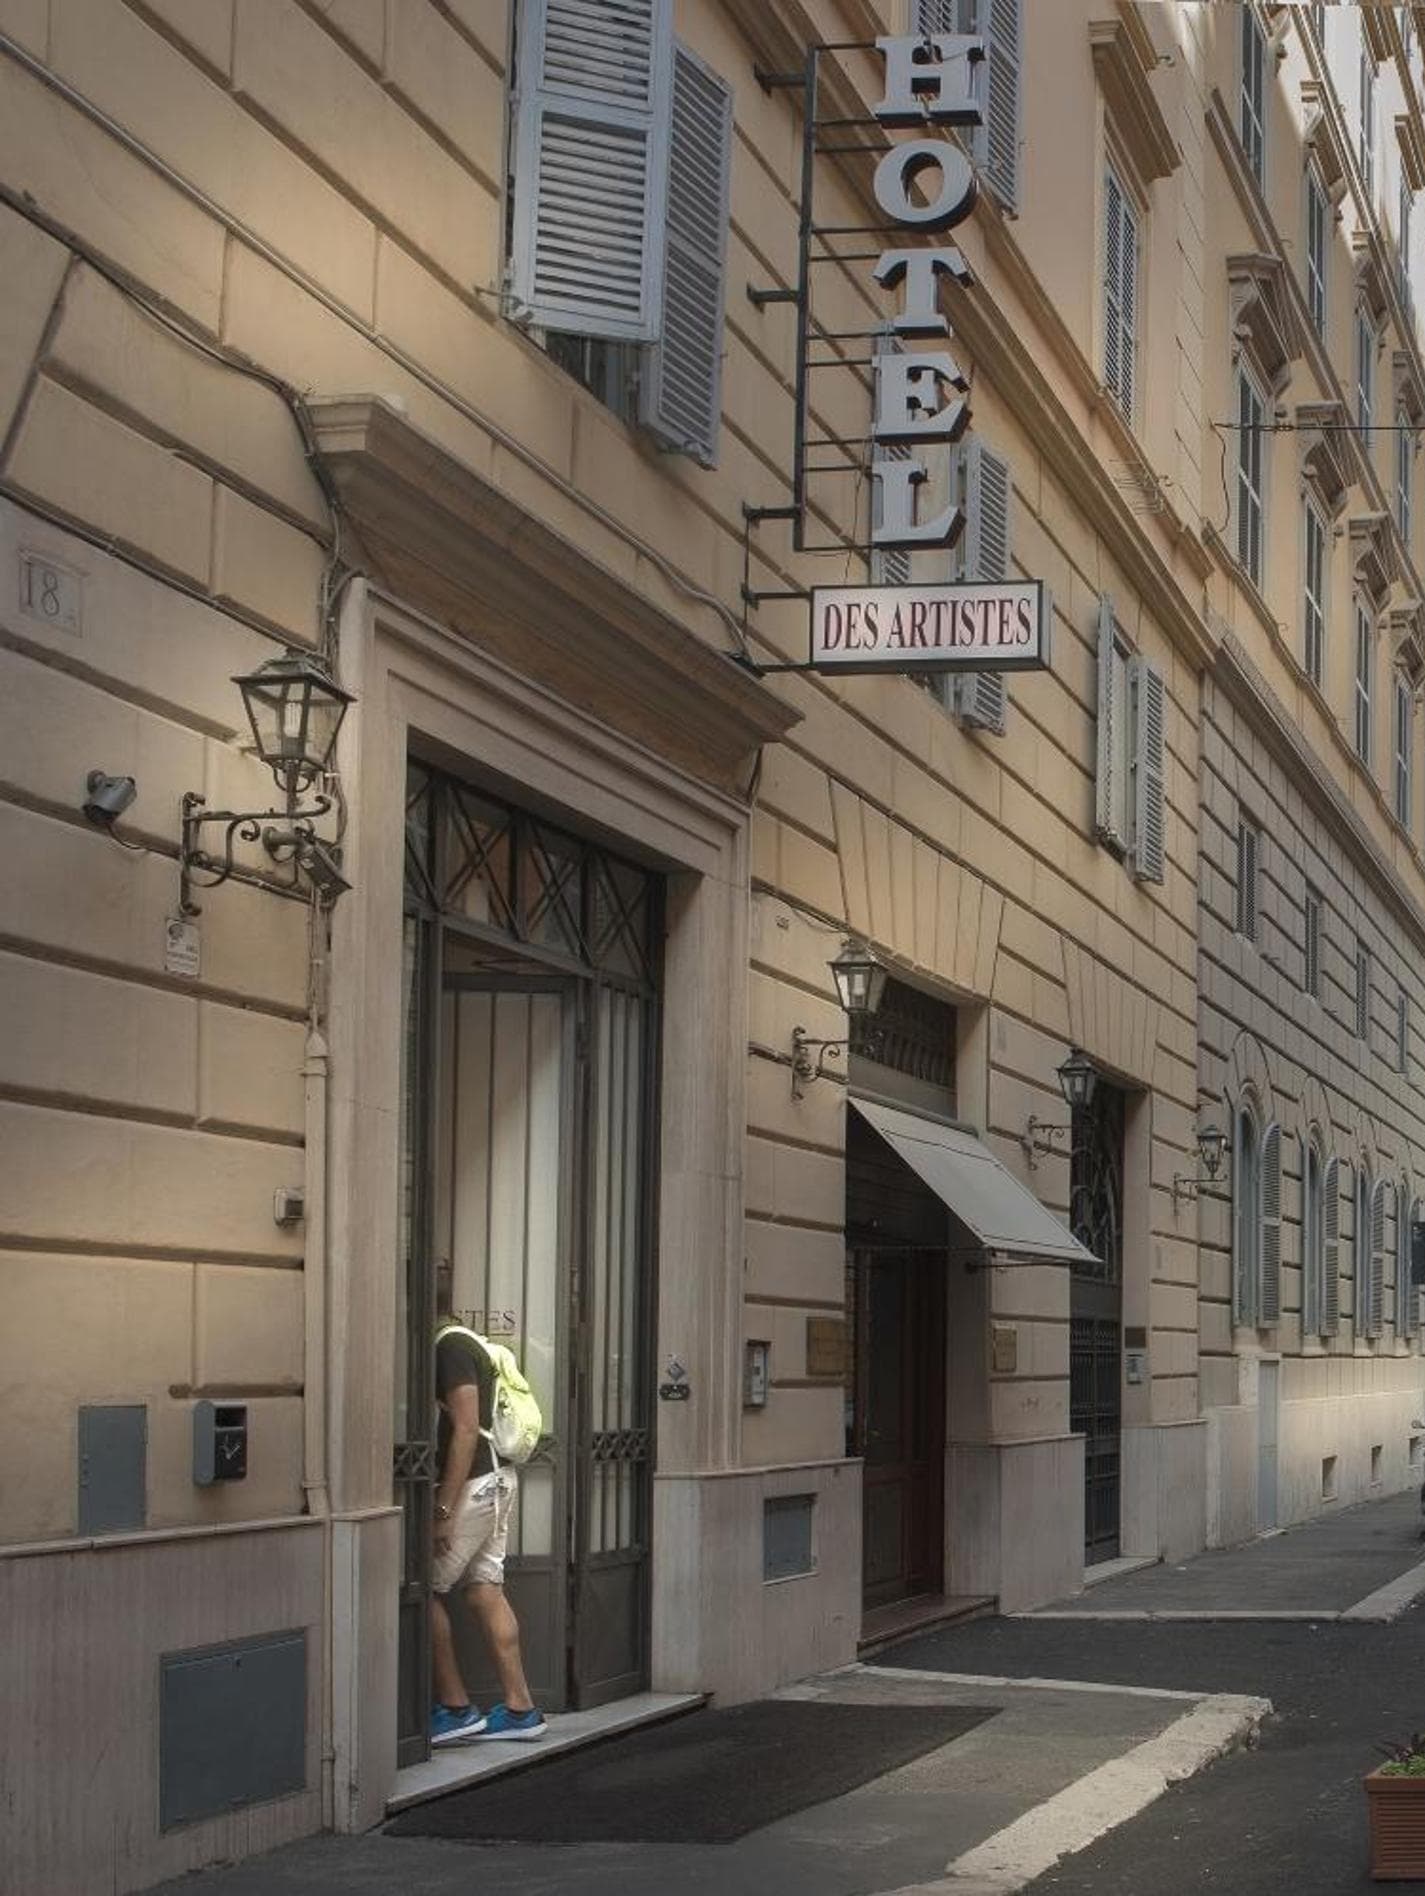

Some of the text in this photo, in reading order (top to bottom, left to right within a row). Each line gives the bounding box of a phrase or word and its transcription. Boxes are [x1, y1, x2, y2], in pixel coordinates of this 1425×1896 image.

[873, 35, 985, 548] HOTEL
[821, 598, 1032, 650] DES ARTISTES
